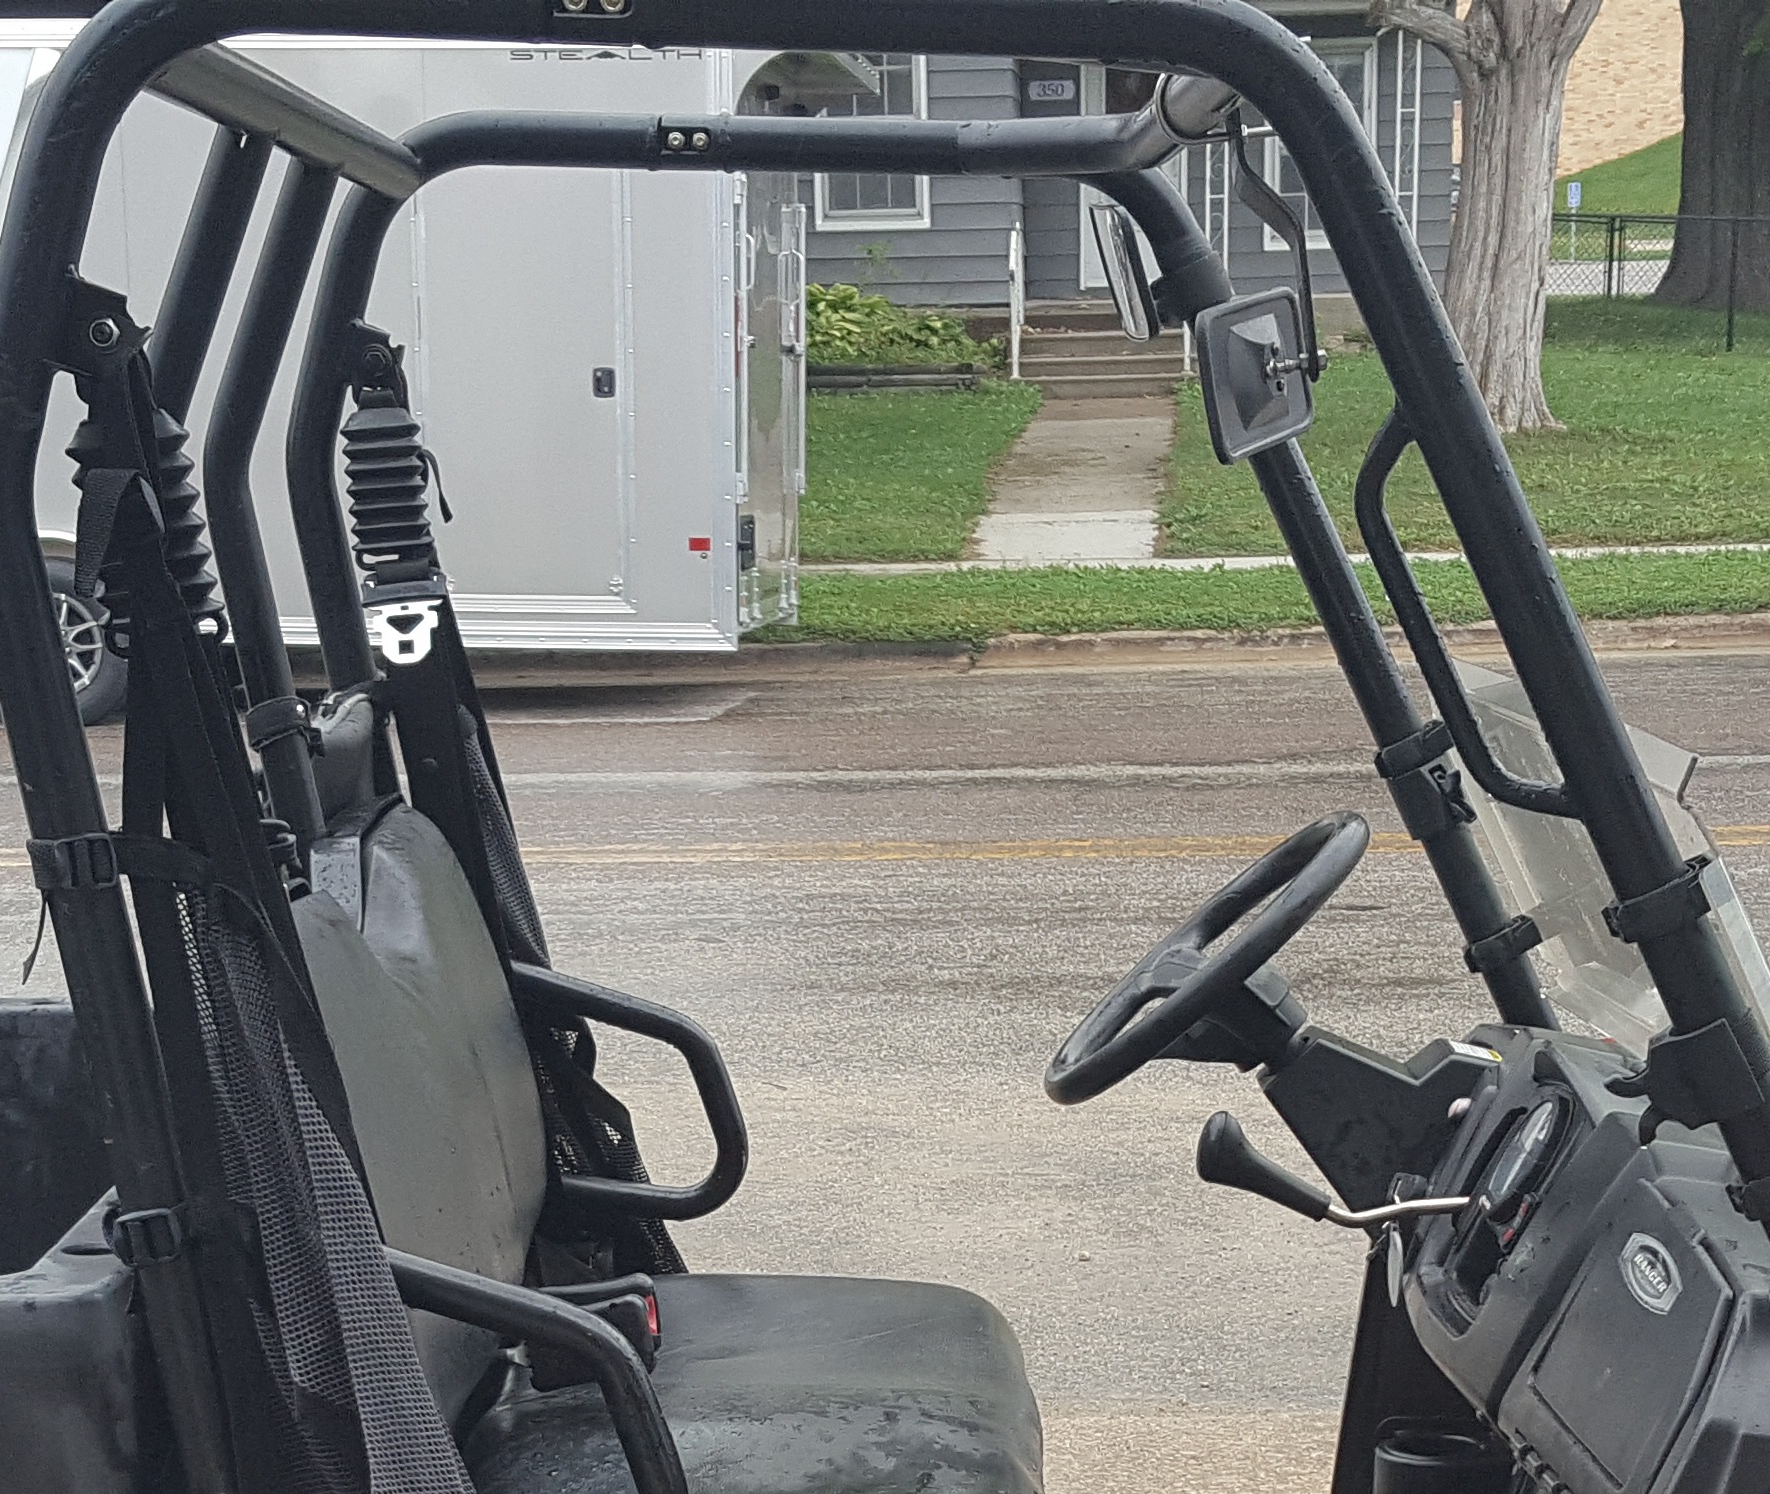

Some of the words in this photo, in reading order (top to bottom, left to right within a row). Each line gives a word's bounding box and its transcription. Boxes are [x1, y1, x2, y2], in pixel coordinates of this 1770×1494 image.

[509, 49, 703, 61] STEALTH
[1037, 82, 1065, 97] 350
[1633, 1253, 1668, 1293] RANGER
